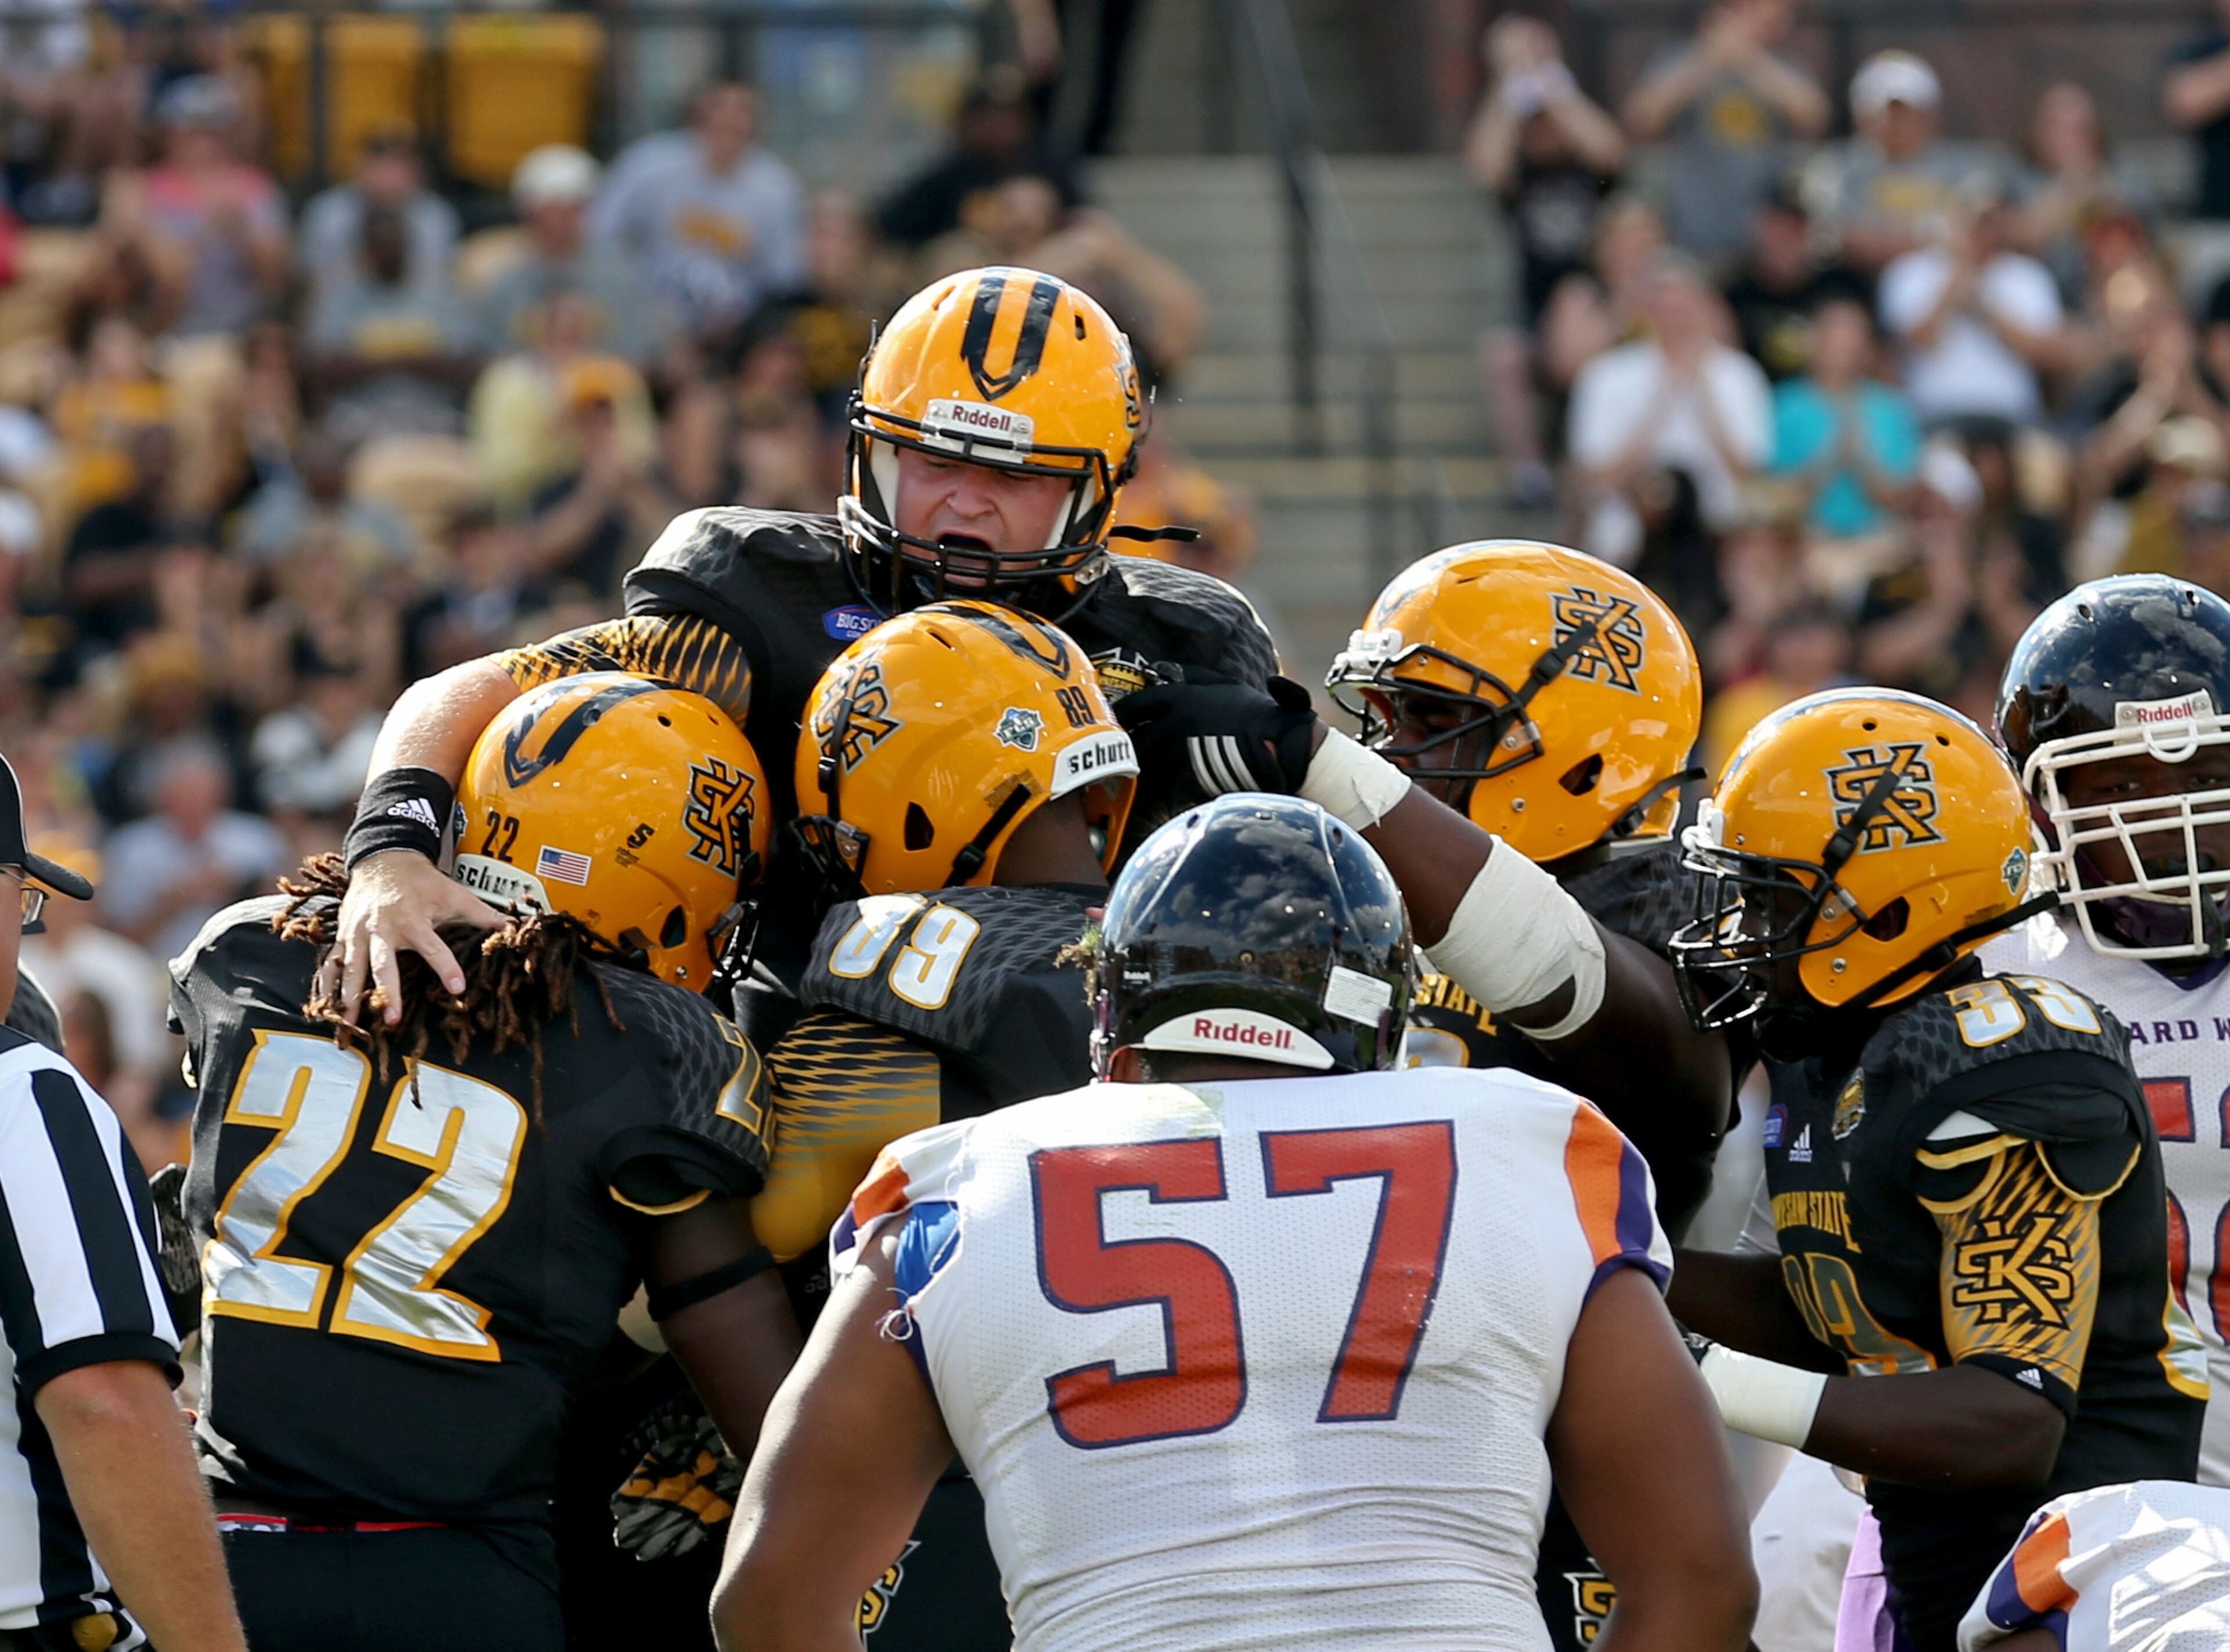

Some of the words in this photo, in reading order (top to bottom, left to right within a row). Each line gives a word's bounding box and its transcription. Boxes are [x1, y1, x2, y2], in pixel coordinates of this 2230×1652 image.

[952, 405, 1012, 431] Riddell
[1055, 686, 1096, 728] 89
[2136, 699, 2193, 723] Riddell
[1069, 739, 1131, 774] schutt
[387, 807, 441, 838] adidas
[481, 811, 520, 863] 22
[1945, 976, 2103, 1048] 33
[1193, 1018, 1292, 1049] Riddell
[202, 1027, 528, 1363] 22
[1027, 1118, 1459, 1450] 57
